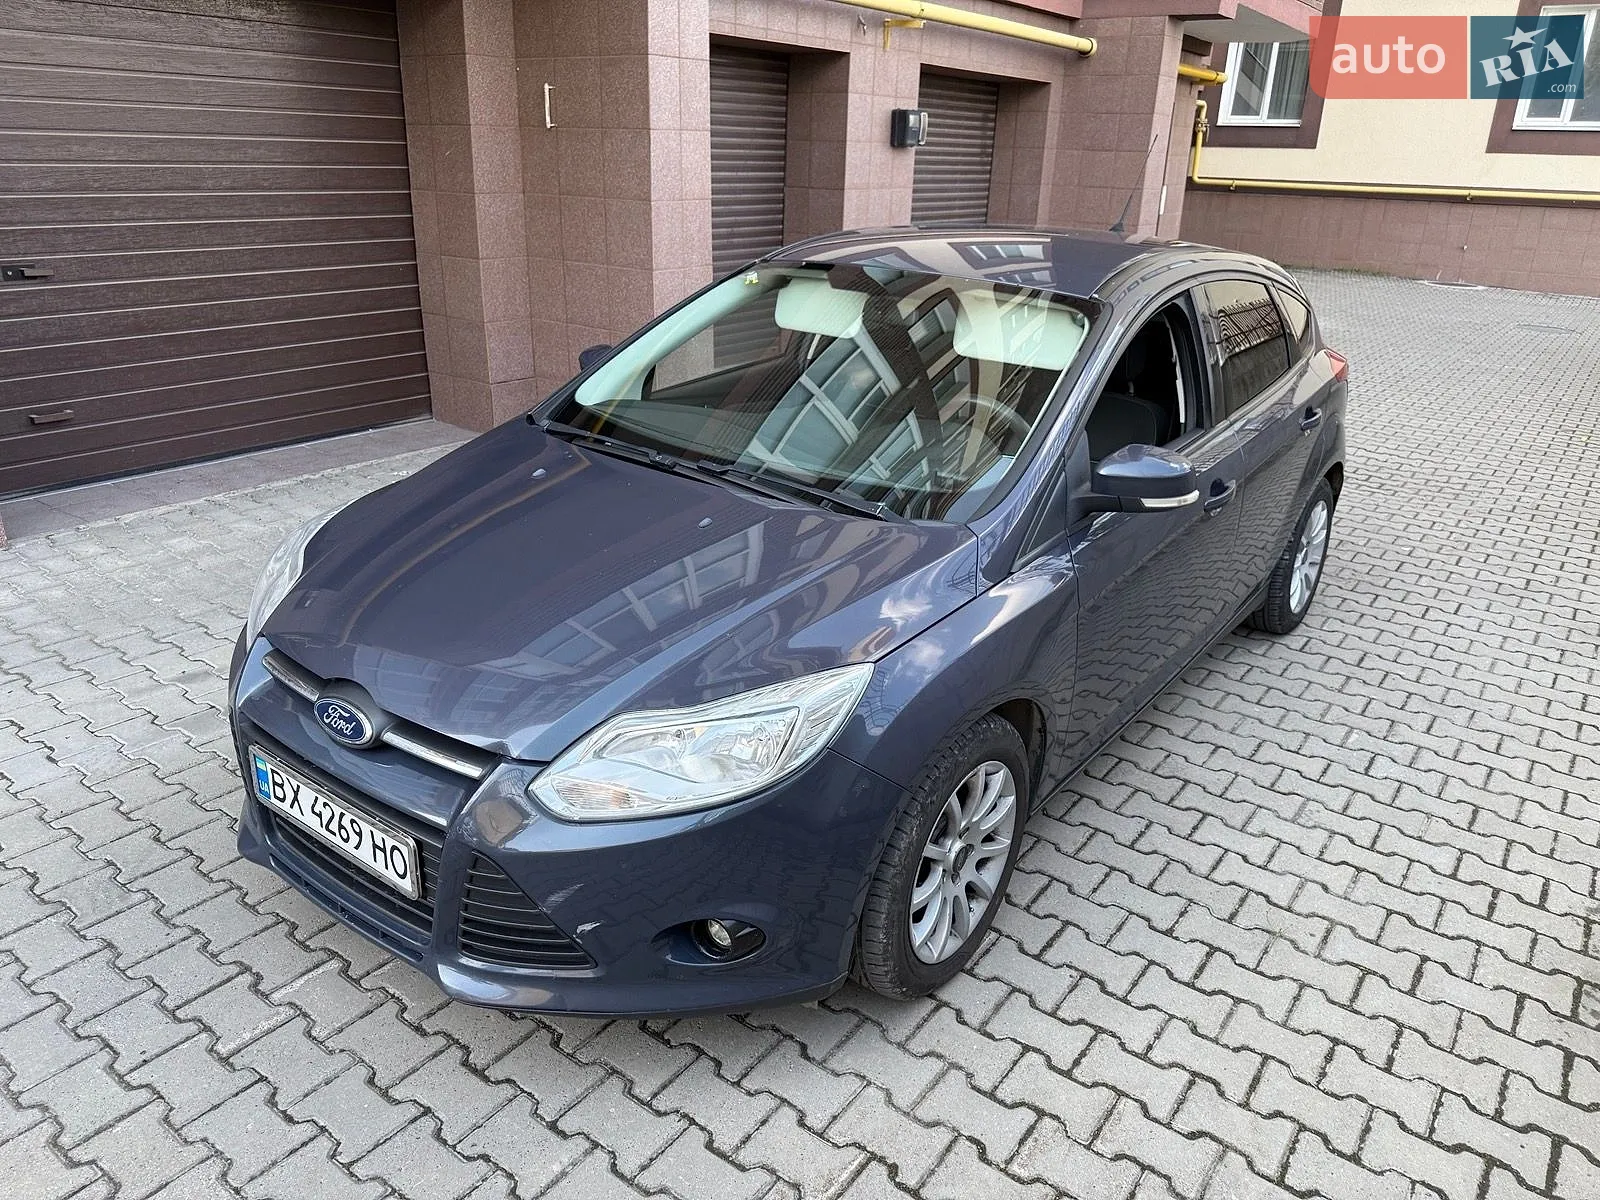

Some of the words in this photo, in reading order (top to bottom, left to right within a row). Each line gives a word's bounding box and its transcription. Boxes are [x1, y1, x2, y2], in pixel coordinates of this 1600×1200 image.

[324, 704, 355, 736] Ford
[259, 779, 270, 794] UA
[311, 796, 364, 851] 4269
[369, 830, 408, 880] HO
